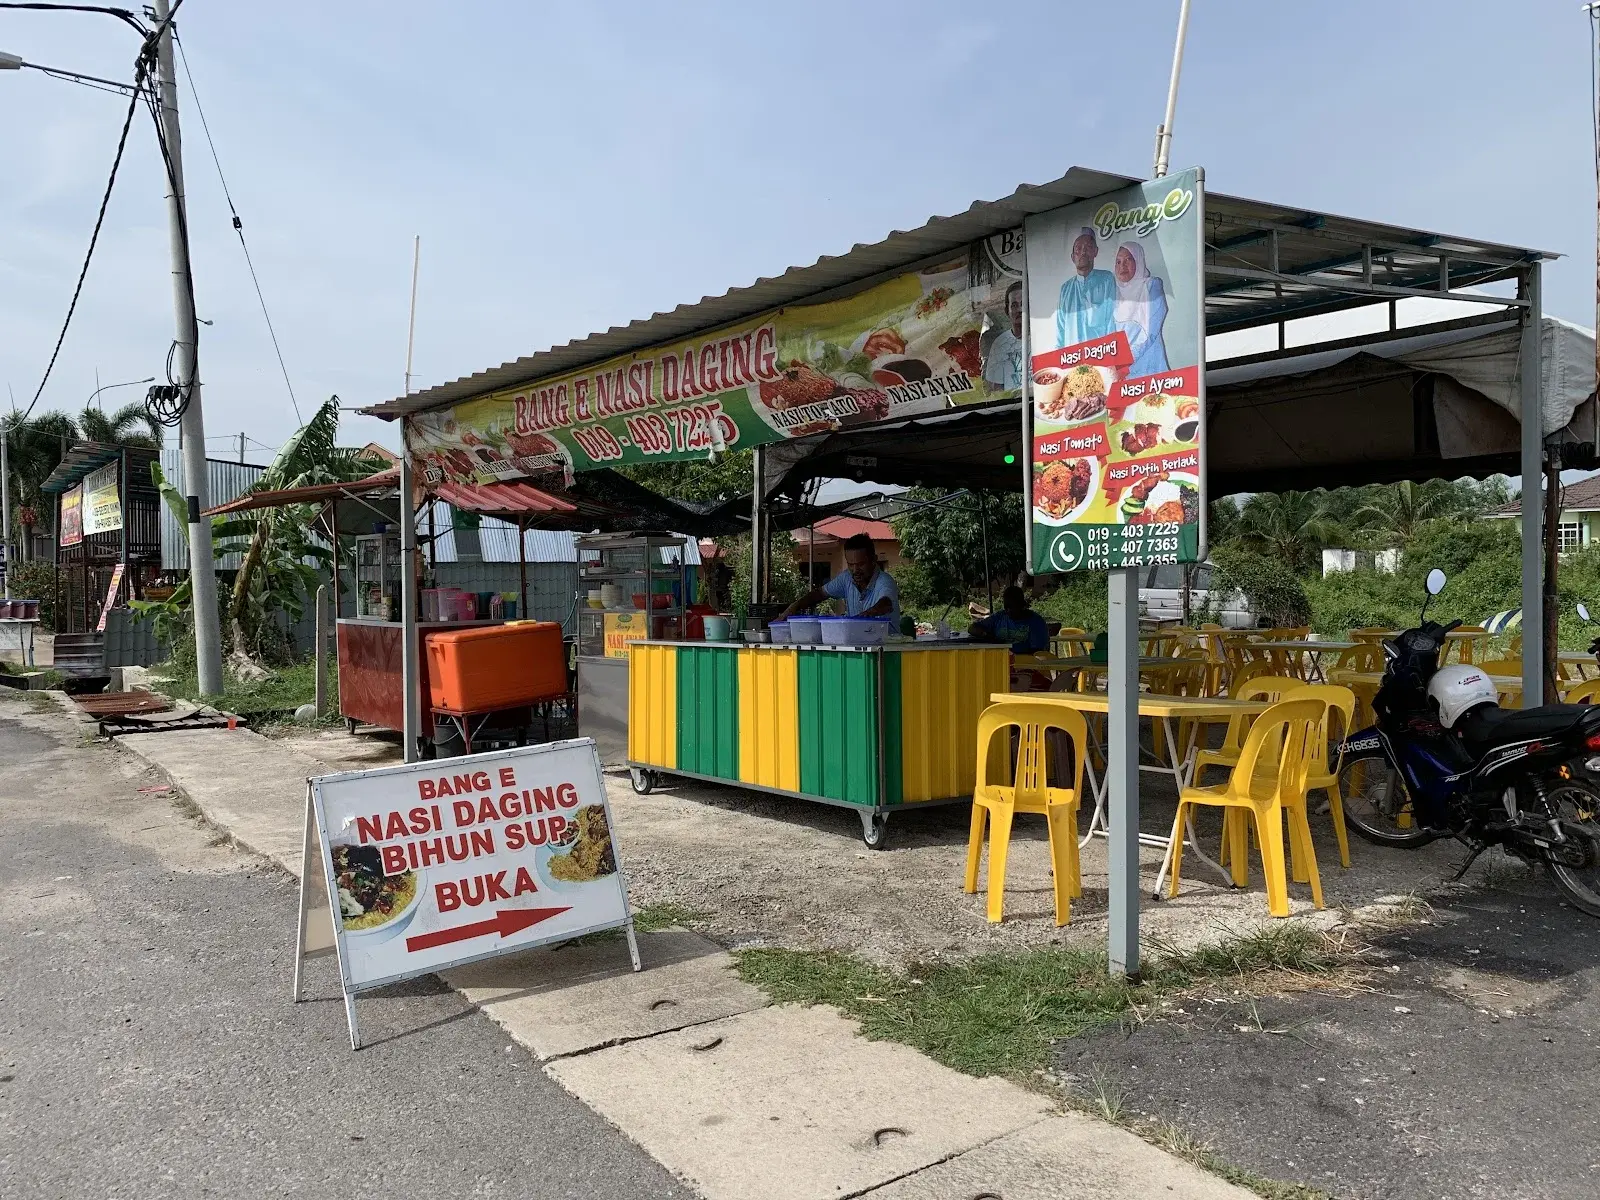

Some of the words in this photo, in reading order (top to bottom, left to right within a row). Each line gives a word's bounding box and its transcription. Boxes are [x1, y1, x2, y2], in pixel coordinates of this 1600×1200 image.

[1094, 202, 1162, 240] Bang
[1060, 348, 1082, 366] Nasi
[1084, 340, 1117, 360] Daging
[514, 388, 572, 435] BANG
[574, 378, 593, 422] E
[595, 359, 659, 419] NASI
[661, 325, 781, 402] DAGING
[887, 381, 926, 405] NASI
[929, 371, 973, 396] AYAM
[1120, 381, 1145, 398] Nasi
[1149, 375, 1183, 394] Ayam
[771, 408, 800, 428] NASI
[573, 427, 622, 459] 019
[625, 413, 671, 453] 403
[1040, 440, 1061, 455] Nasi
[1063, 433, 1103, 451] Tomato
[1109, 465, 1129, 480] Nasi
[1131, 460, 1159, 477] Putih
[1162, 454, 1198, 470] Berlauk
[1088, 527, 1109, 541] 019
[1121, 525, 1144, 538] 403
[1147, 521, 1179, 536] 7225
[1088, 543, 1109, 556] 013
[1121, 540, 1143, 553] 407
[1147, 537, 1178, 552] 7363
[1088, 558, 1109, 570] 013
[1121, 555, 1143, 567] 445
[1147, 553, 1178, 565] 2355
[418, 771, 492, 801] BANG
[500, 767, 516, 788] E
[356, 804, 443, 845] NASI
[452, 782, 579, 828] DAGING
[381, 827, 496, 875] BIHUN
[504, 815, 567, 850] SUP
[435, 866, 539, 913] BUKA
